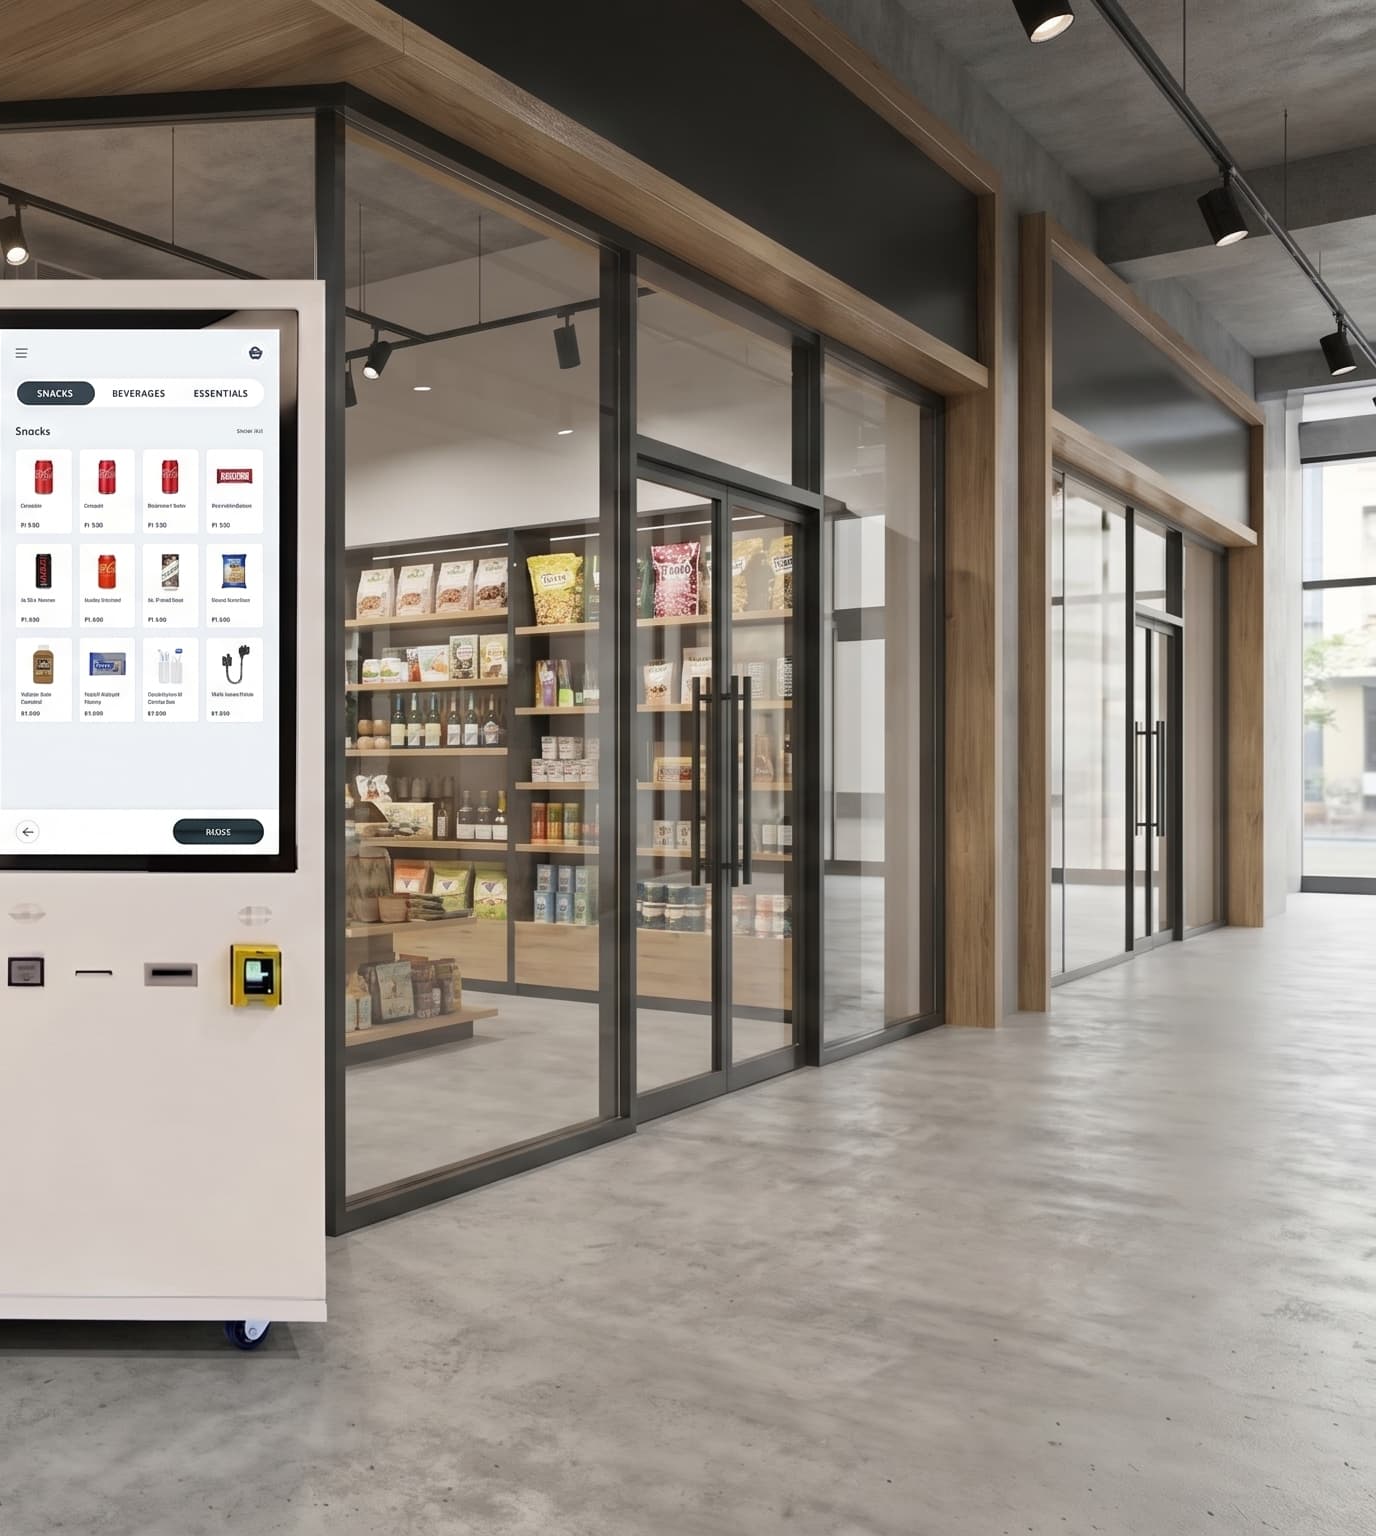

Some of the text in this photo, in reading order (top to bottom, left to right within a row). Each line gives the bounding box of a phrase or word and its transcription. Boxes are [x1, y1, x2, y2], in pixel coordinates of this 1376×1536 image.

[36, 388, 73, 399] SNACKS
[112, 388, 166, 399] BEVERAGES
[193, 388, 249, 399] ESSENTIALS
[15, 425, 51, 437] Snacks
